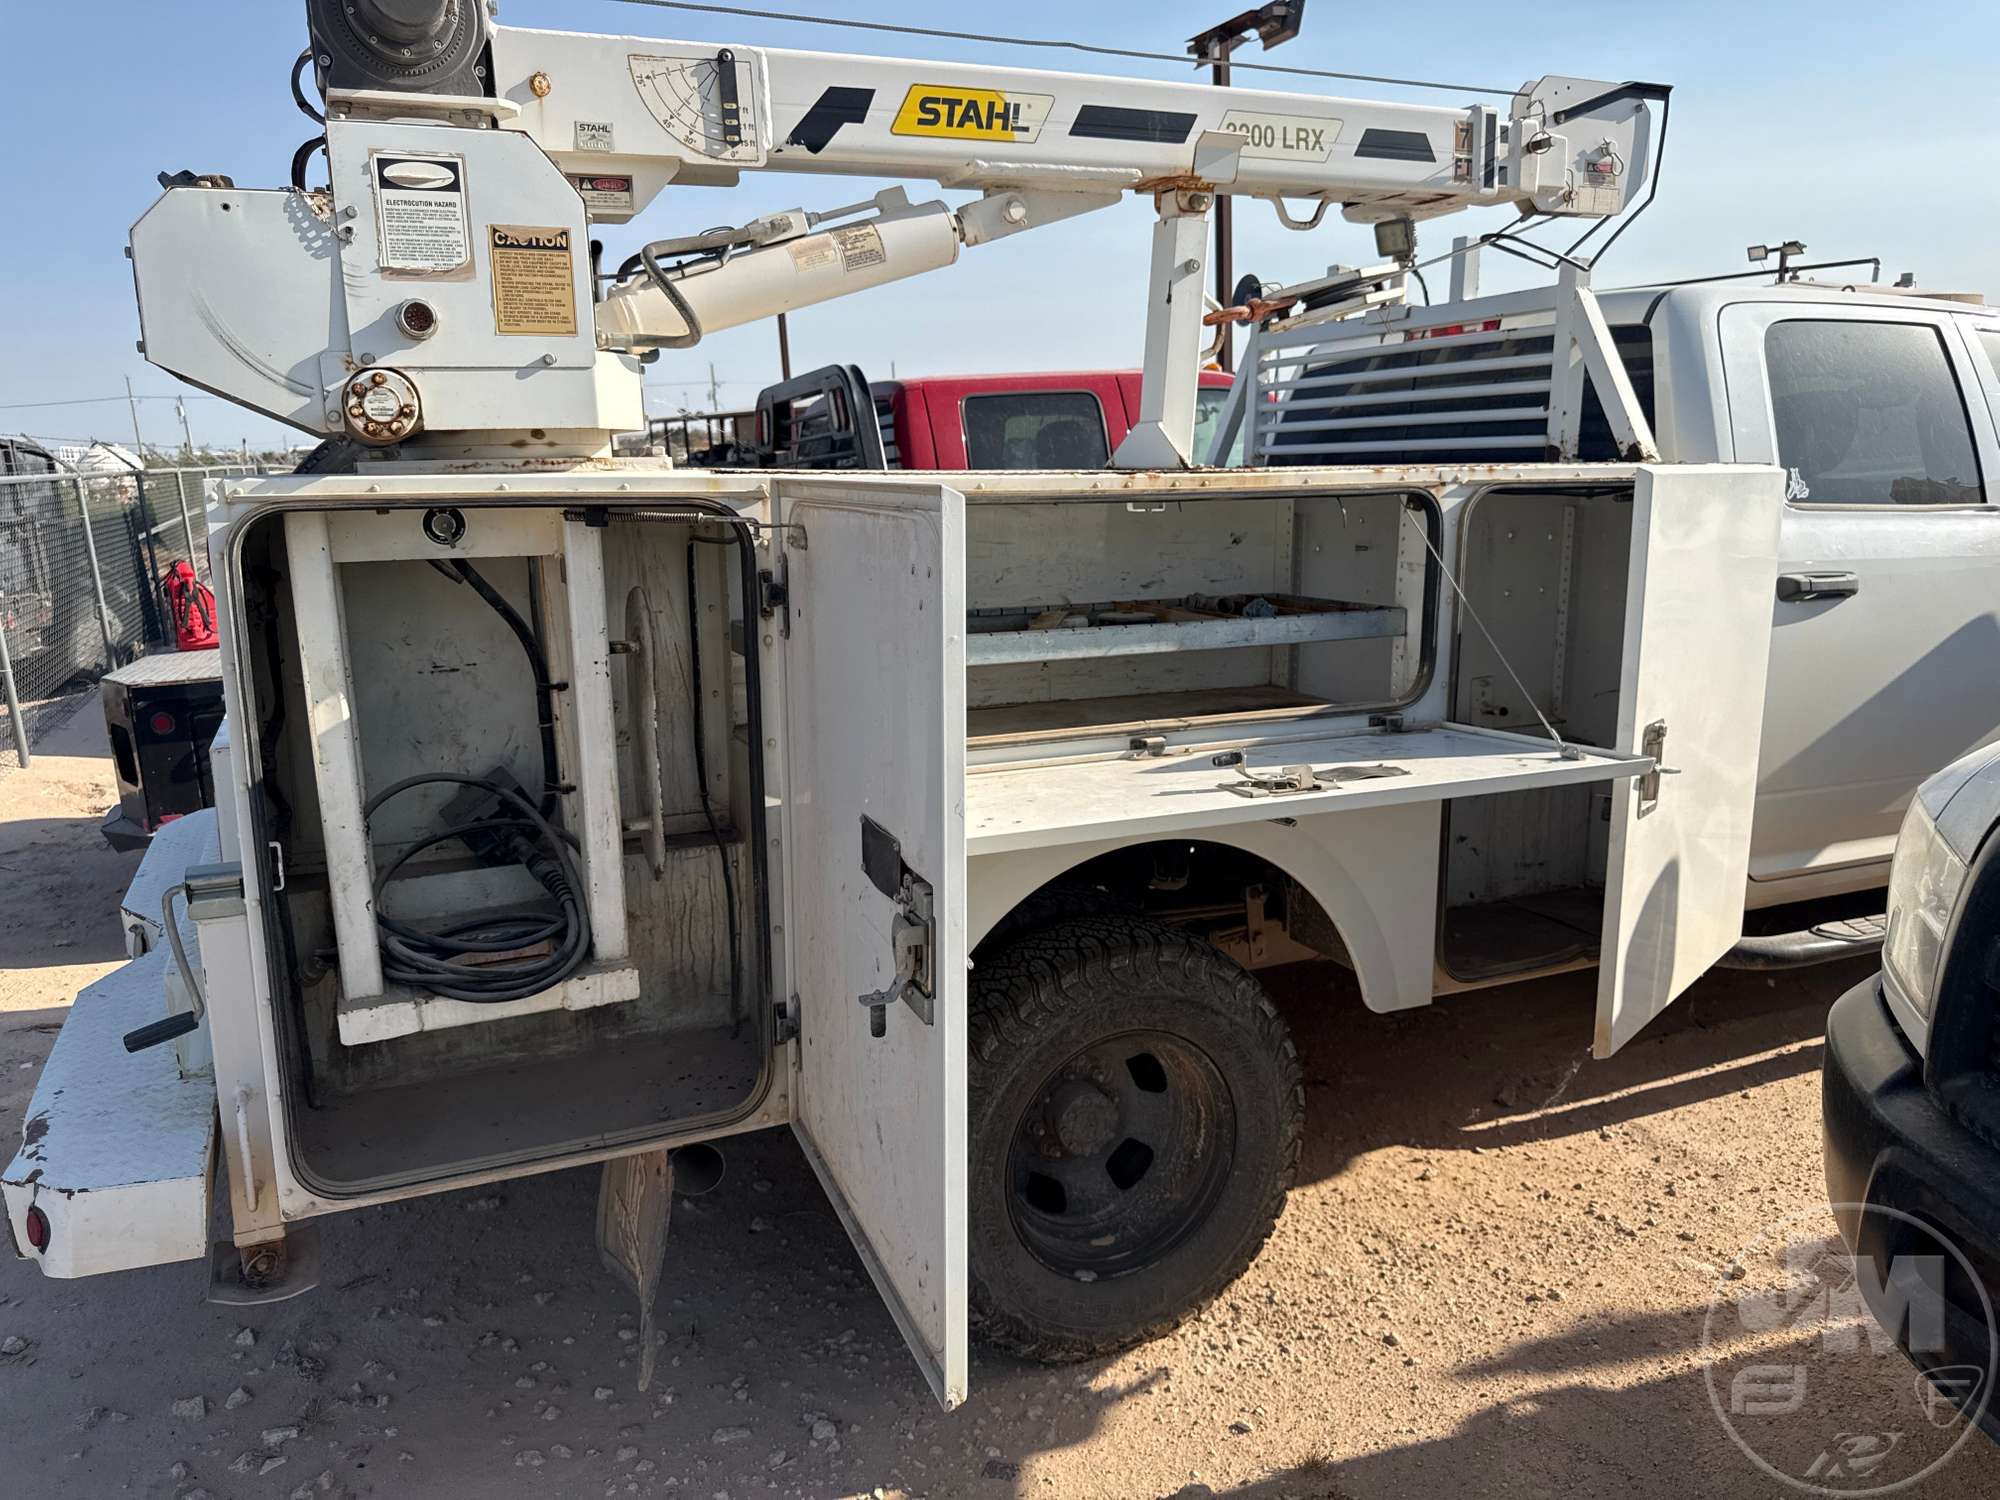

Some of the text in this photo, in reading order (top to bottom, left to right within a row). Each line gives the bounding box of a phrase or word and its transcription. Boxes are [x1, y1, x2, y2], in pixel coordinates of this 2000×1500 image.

[916, 96, 1030, 133] STAHL
[579, 124, 611, 133] STAHL
[1460, 128, 1469, 148] 7
[1282, 126, 1325, 152] LRX
[386, 199, 457, 208] ELECTROCUTION HAZARD
